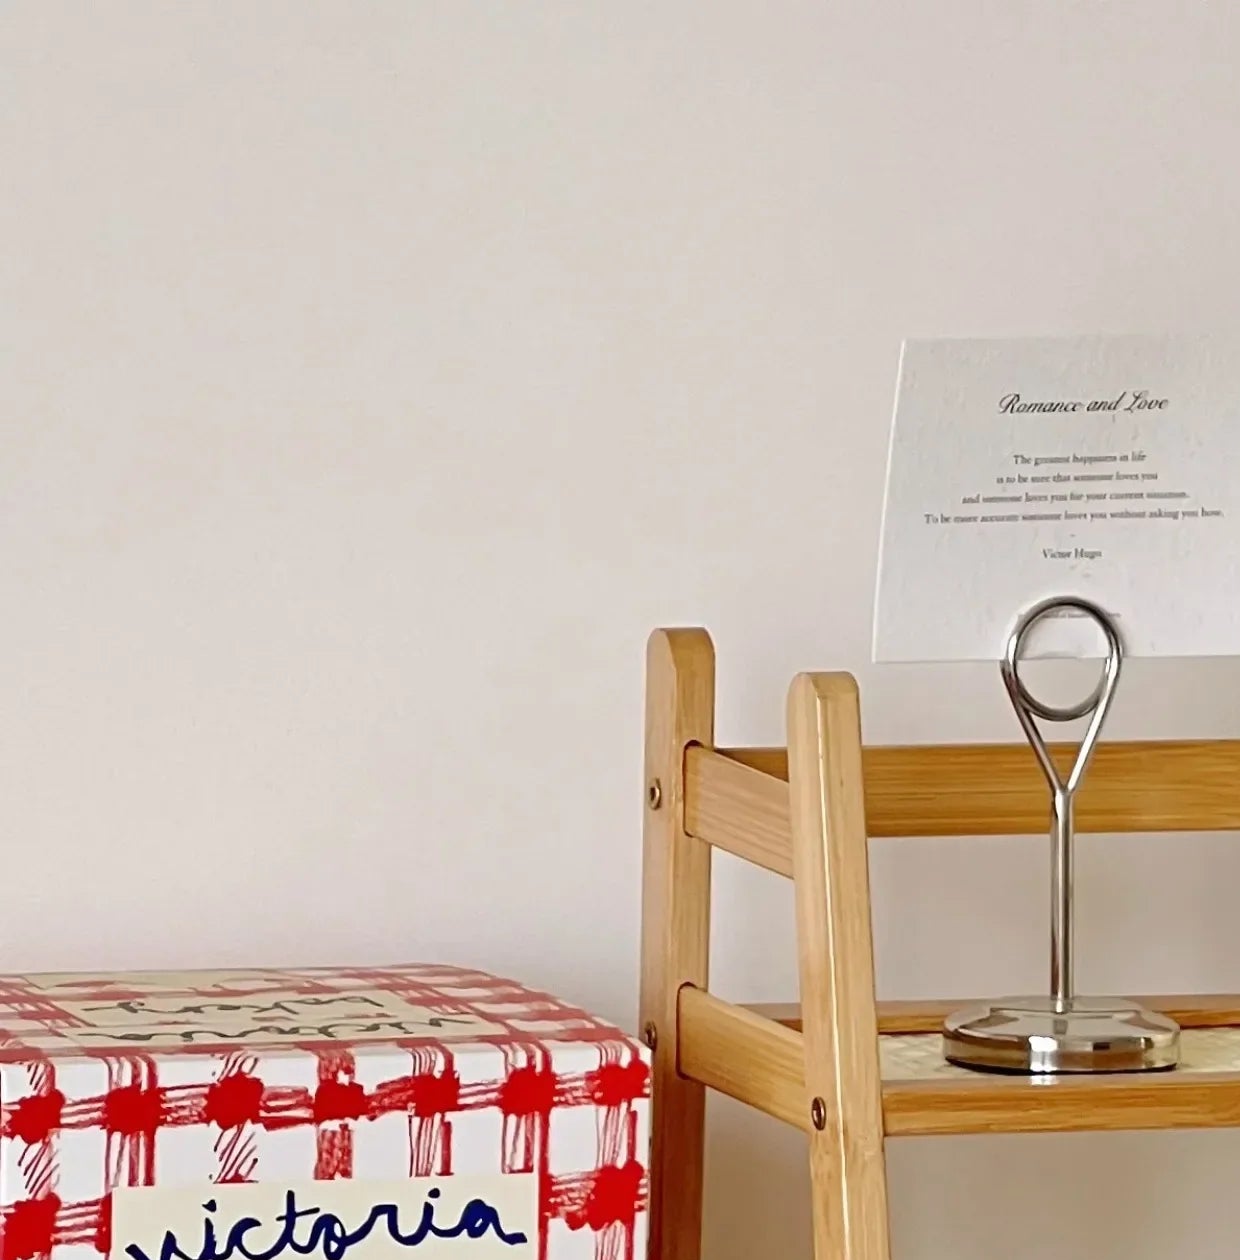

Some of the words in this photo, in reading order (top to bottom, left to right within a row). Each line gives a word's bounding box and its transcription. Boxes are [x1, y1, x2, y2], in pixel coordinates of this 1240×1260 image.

[999, 393, 1081, 414] Romance
[1086, 391, 1127, 412] and
[1124, 390, 1169, 413] Love
[1013, 454, 1031, 464] The
